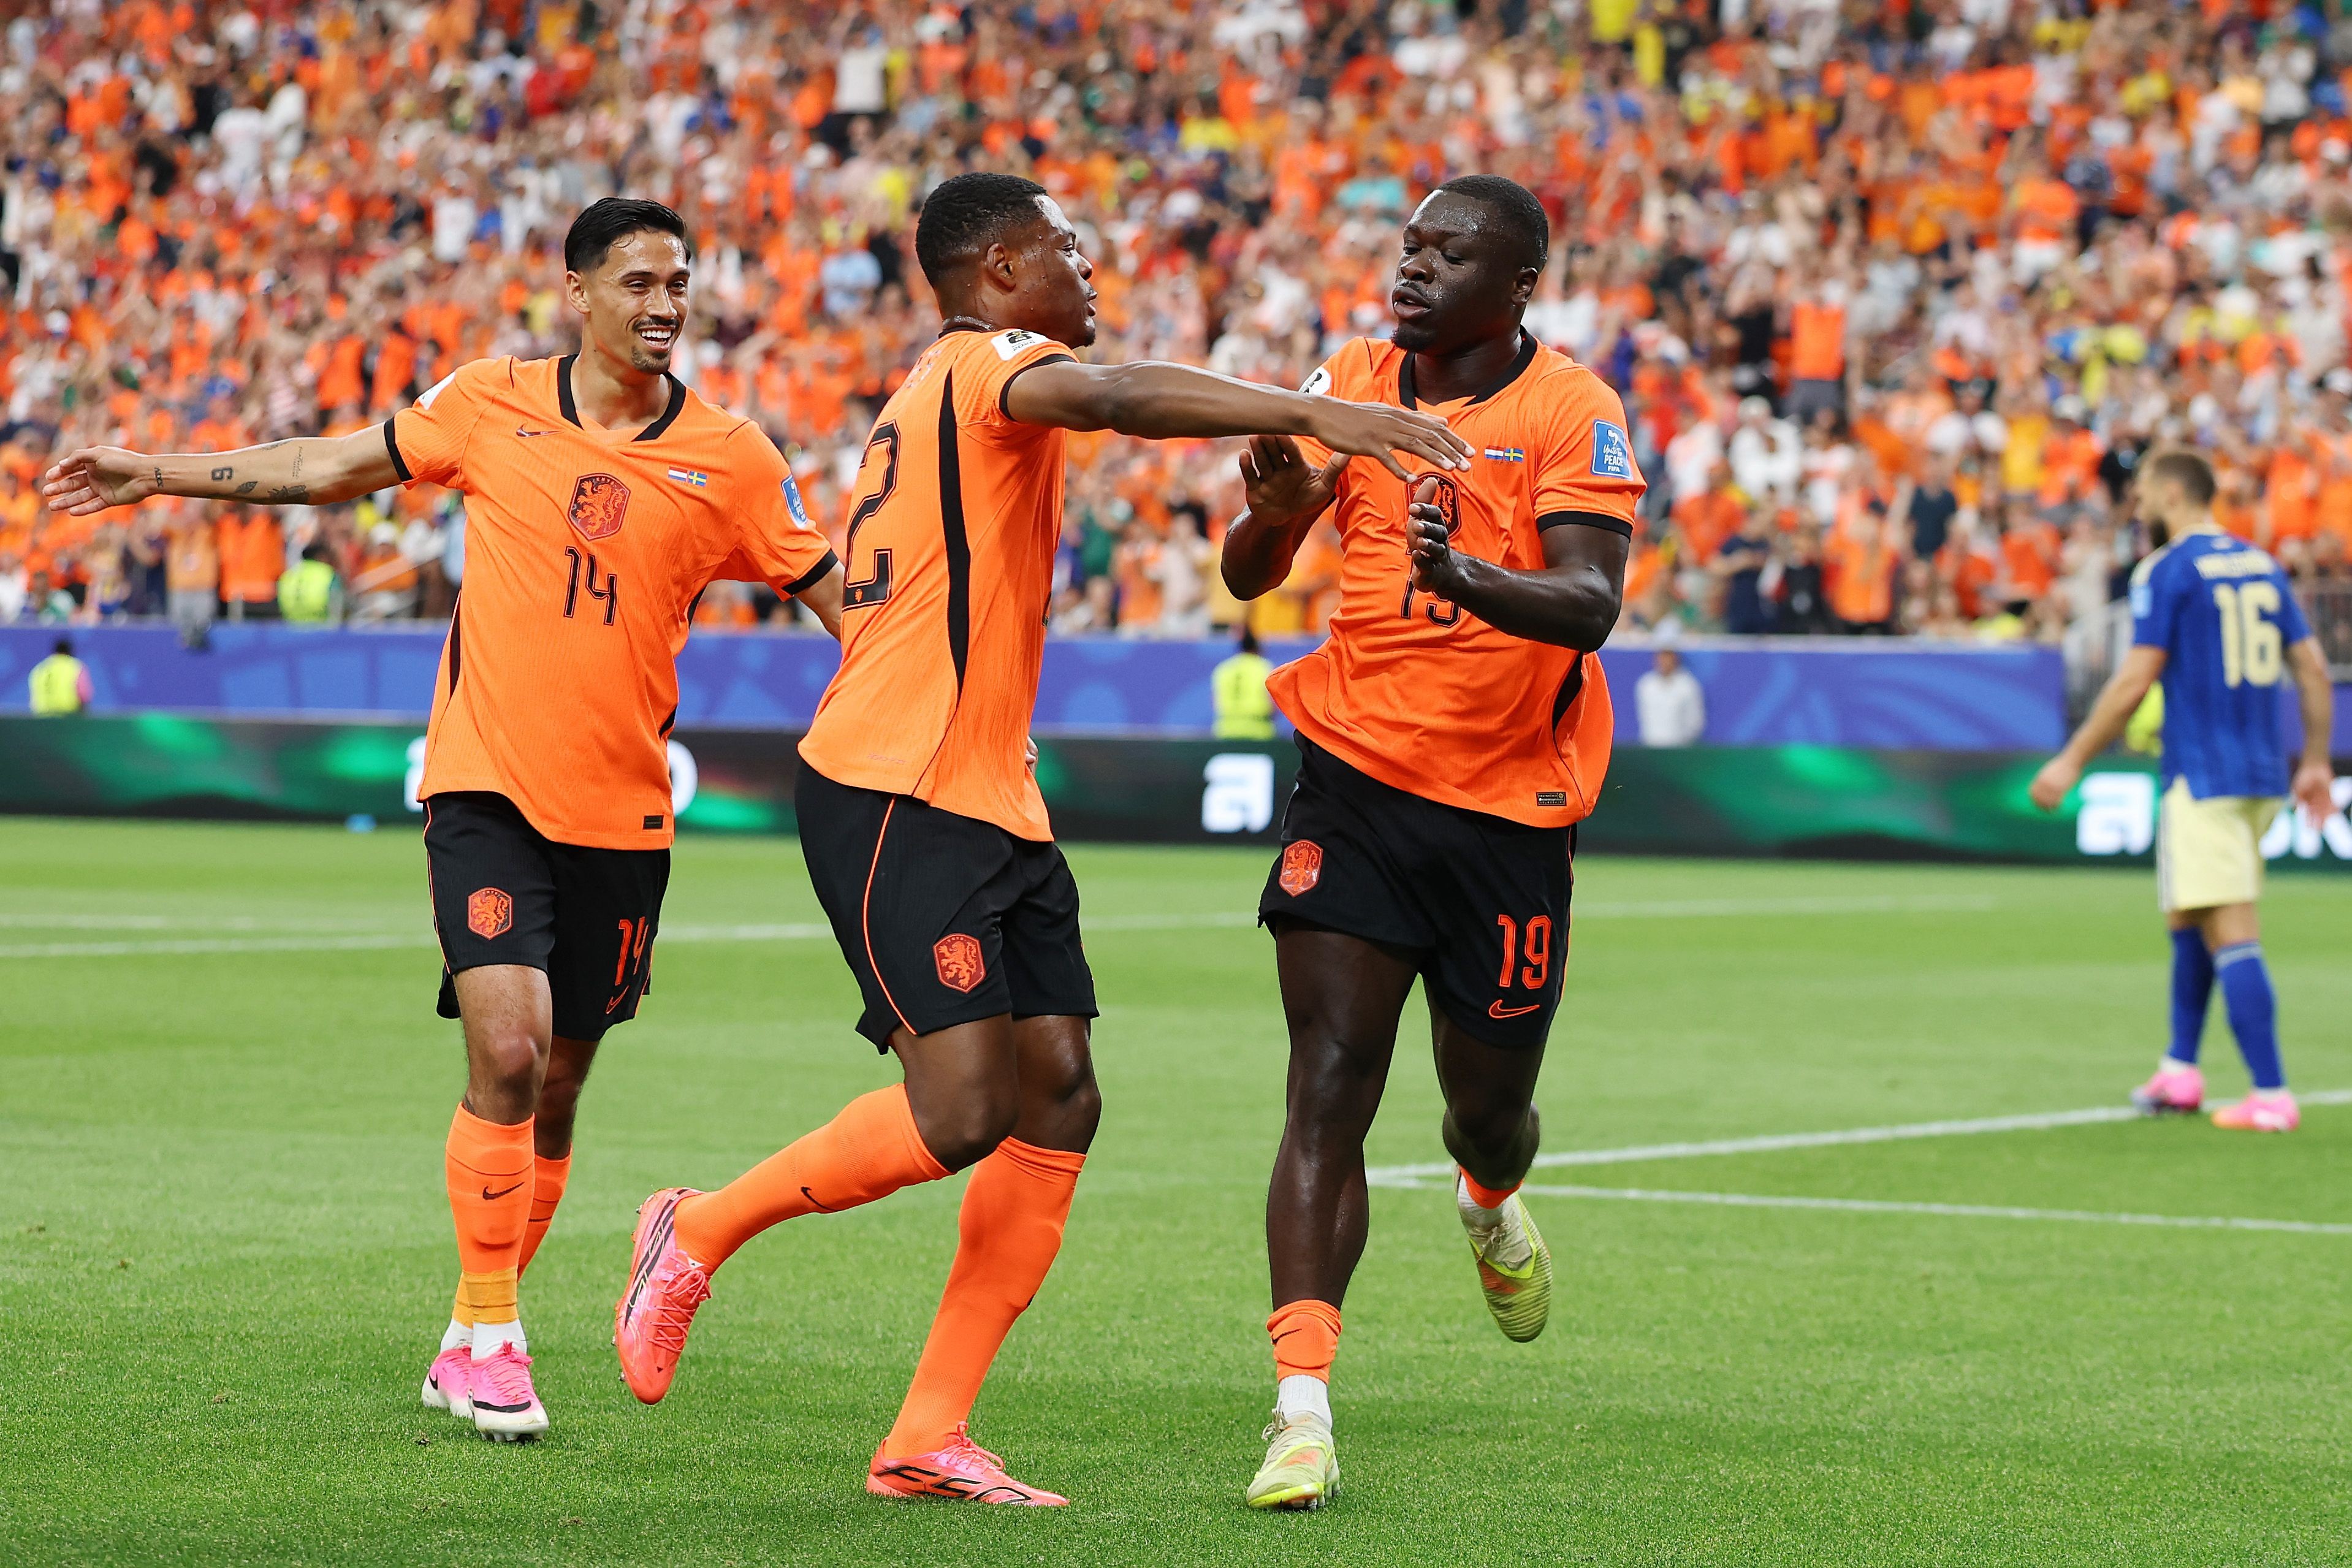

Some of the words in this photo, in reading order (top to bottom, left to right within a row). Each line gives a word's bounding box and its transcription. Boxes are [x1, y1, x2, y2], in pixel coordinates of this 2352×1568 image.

[1604, 454, 1624, 467] PEACE
[563, 546, 617, 626] 14
[2213, 580, 2283, 689] 16
[614, 916, 649, 986] 14
[1497, 914, 1552, 989] 19
